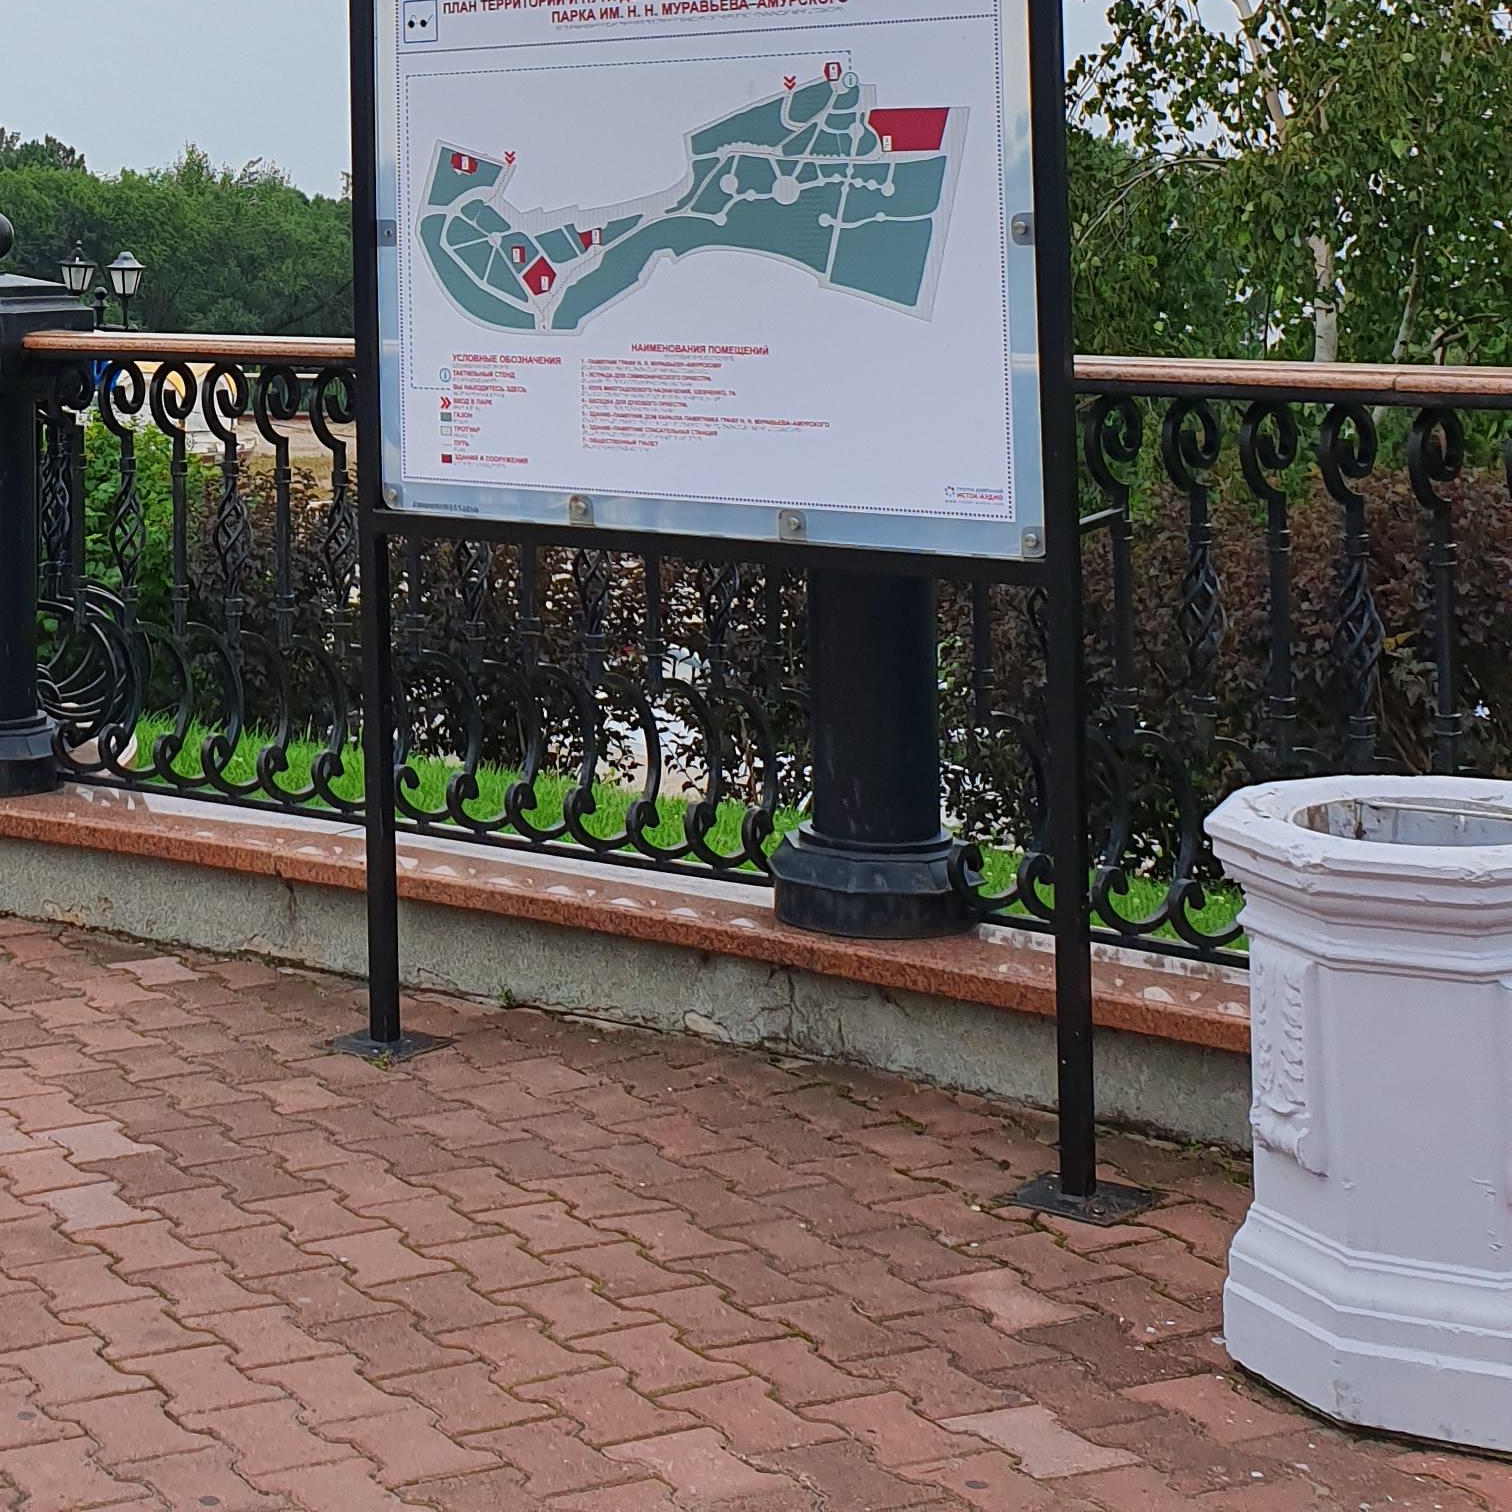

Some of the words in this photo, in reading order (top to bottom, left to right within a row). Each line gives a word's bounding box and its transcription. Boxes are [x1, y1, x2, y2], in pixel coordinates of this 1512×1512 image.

[442, 2, 477, 14] ПЛАН
[551, 8, 596, 24] ПАРКА
[600, 6, 624, 20] ИМ.
[628, 5, 641, 18] Н.
[645, 4, 658, 17] Н.
[631, 344, 706, 354] НАИМЕНОВАНИЯ
[708, 344, 769, 356] ПОМЕЩЕНИЙ
[452, 354, 498, 364] УСЛОВНЫЕ
[499, 355, 562, 365] ОБОЗНАЧЕНИЯ
